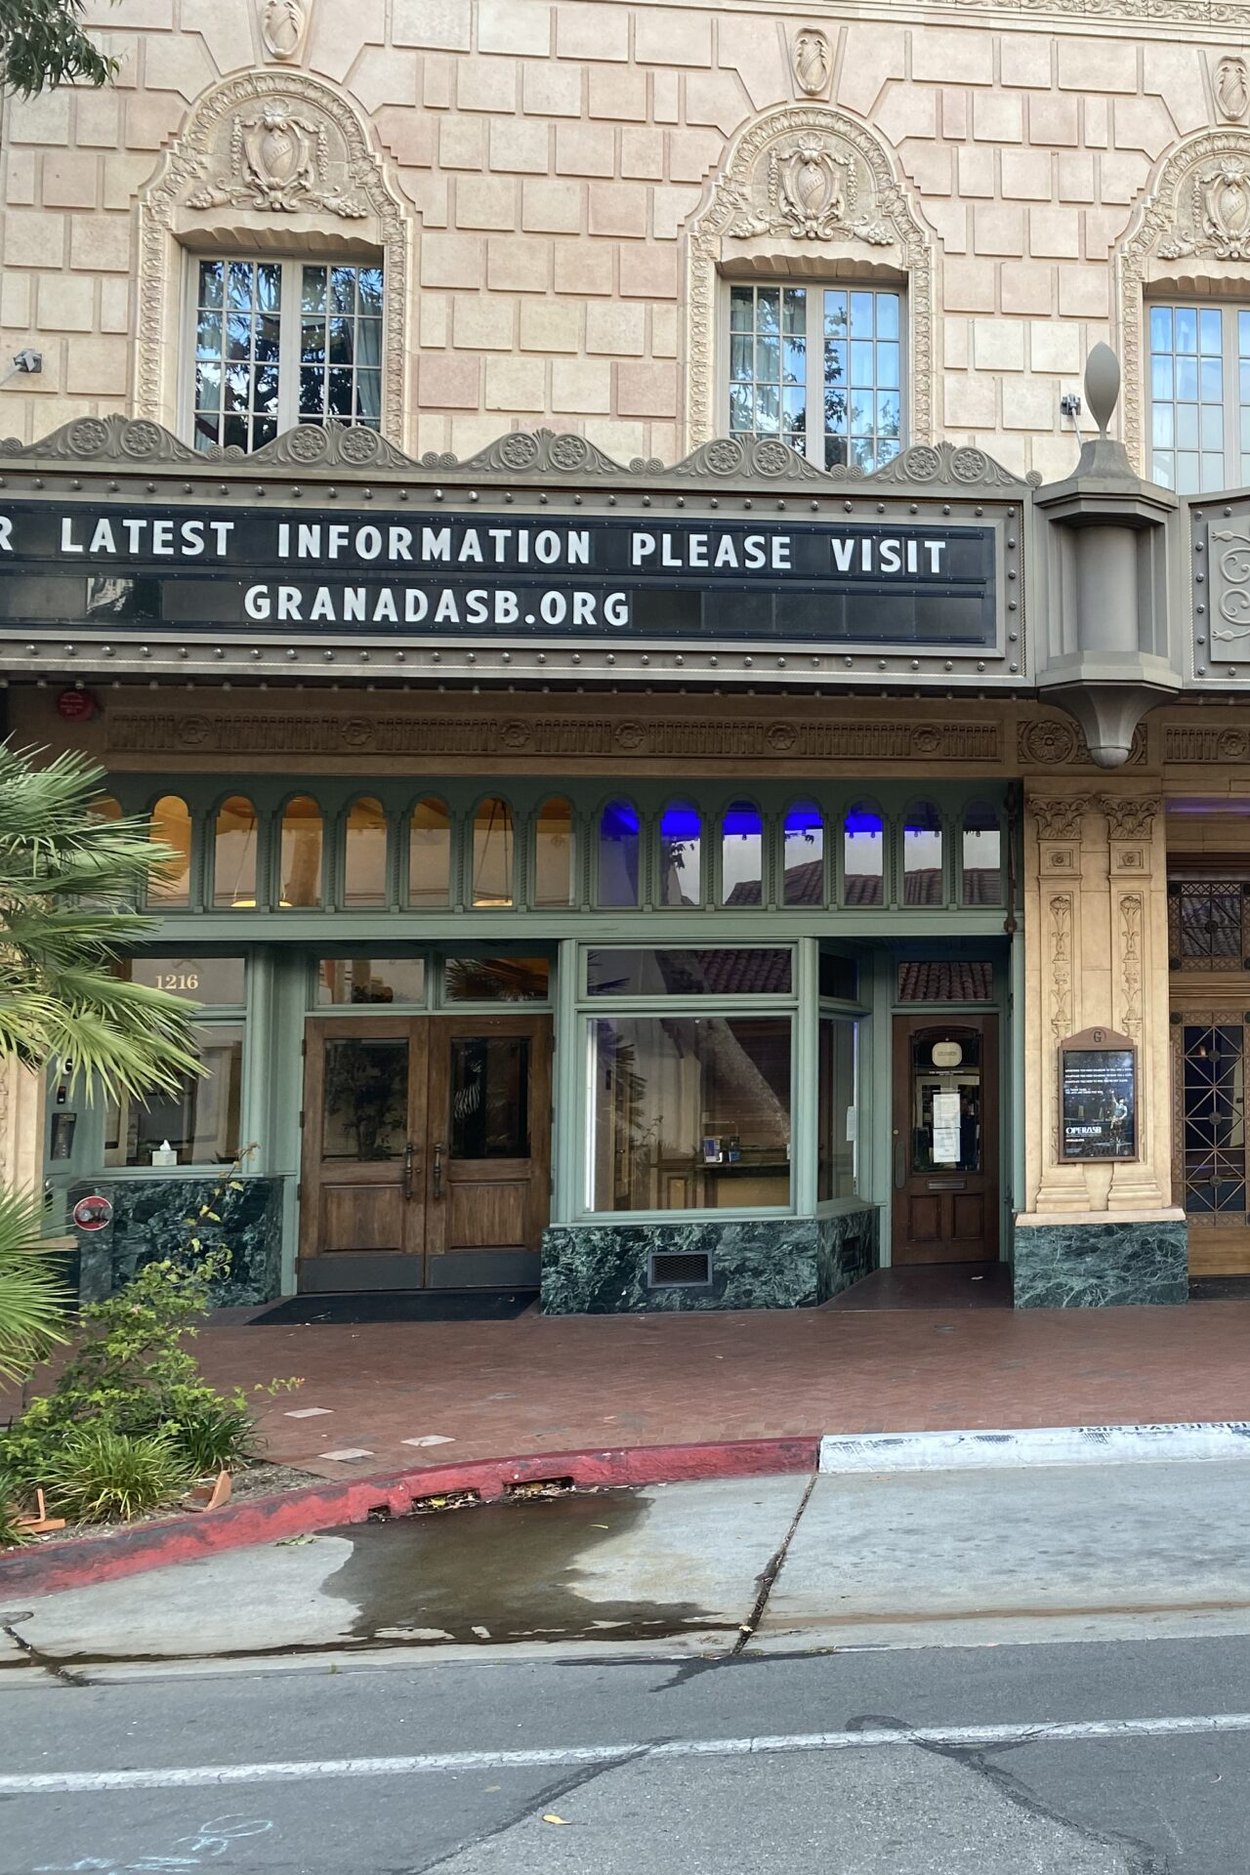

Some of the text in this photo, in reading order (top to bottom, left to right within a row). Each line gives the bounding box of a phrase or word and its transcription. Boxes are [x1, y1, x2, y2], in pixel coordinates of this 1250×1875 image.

[61, 517, 235, 556] LATEST
[278, 523, 590, 564] INFORMATION
[632, 532, 792, 569] PLEASE
[831, 538, 946, 574] VISIT
[244, 584, 630, 627] GRANADASB.ORG
[156, 974, 199, 990] 1216
